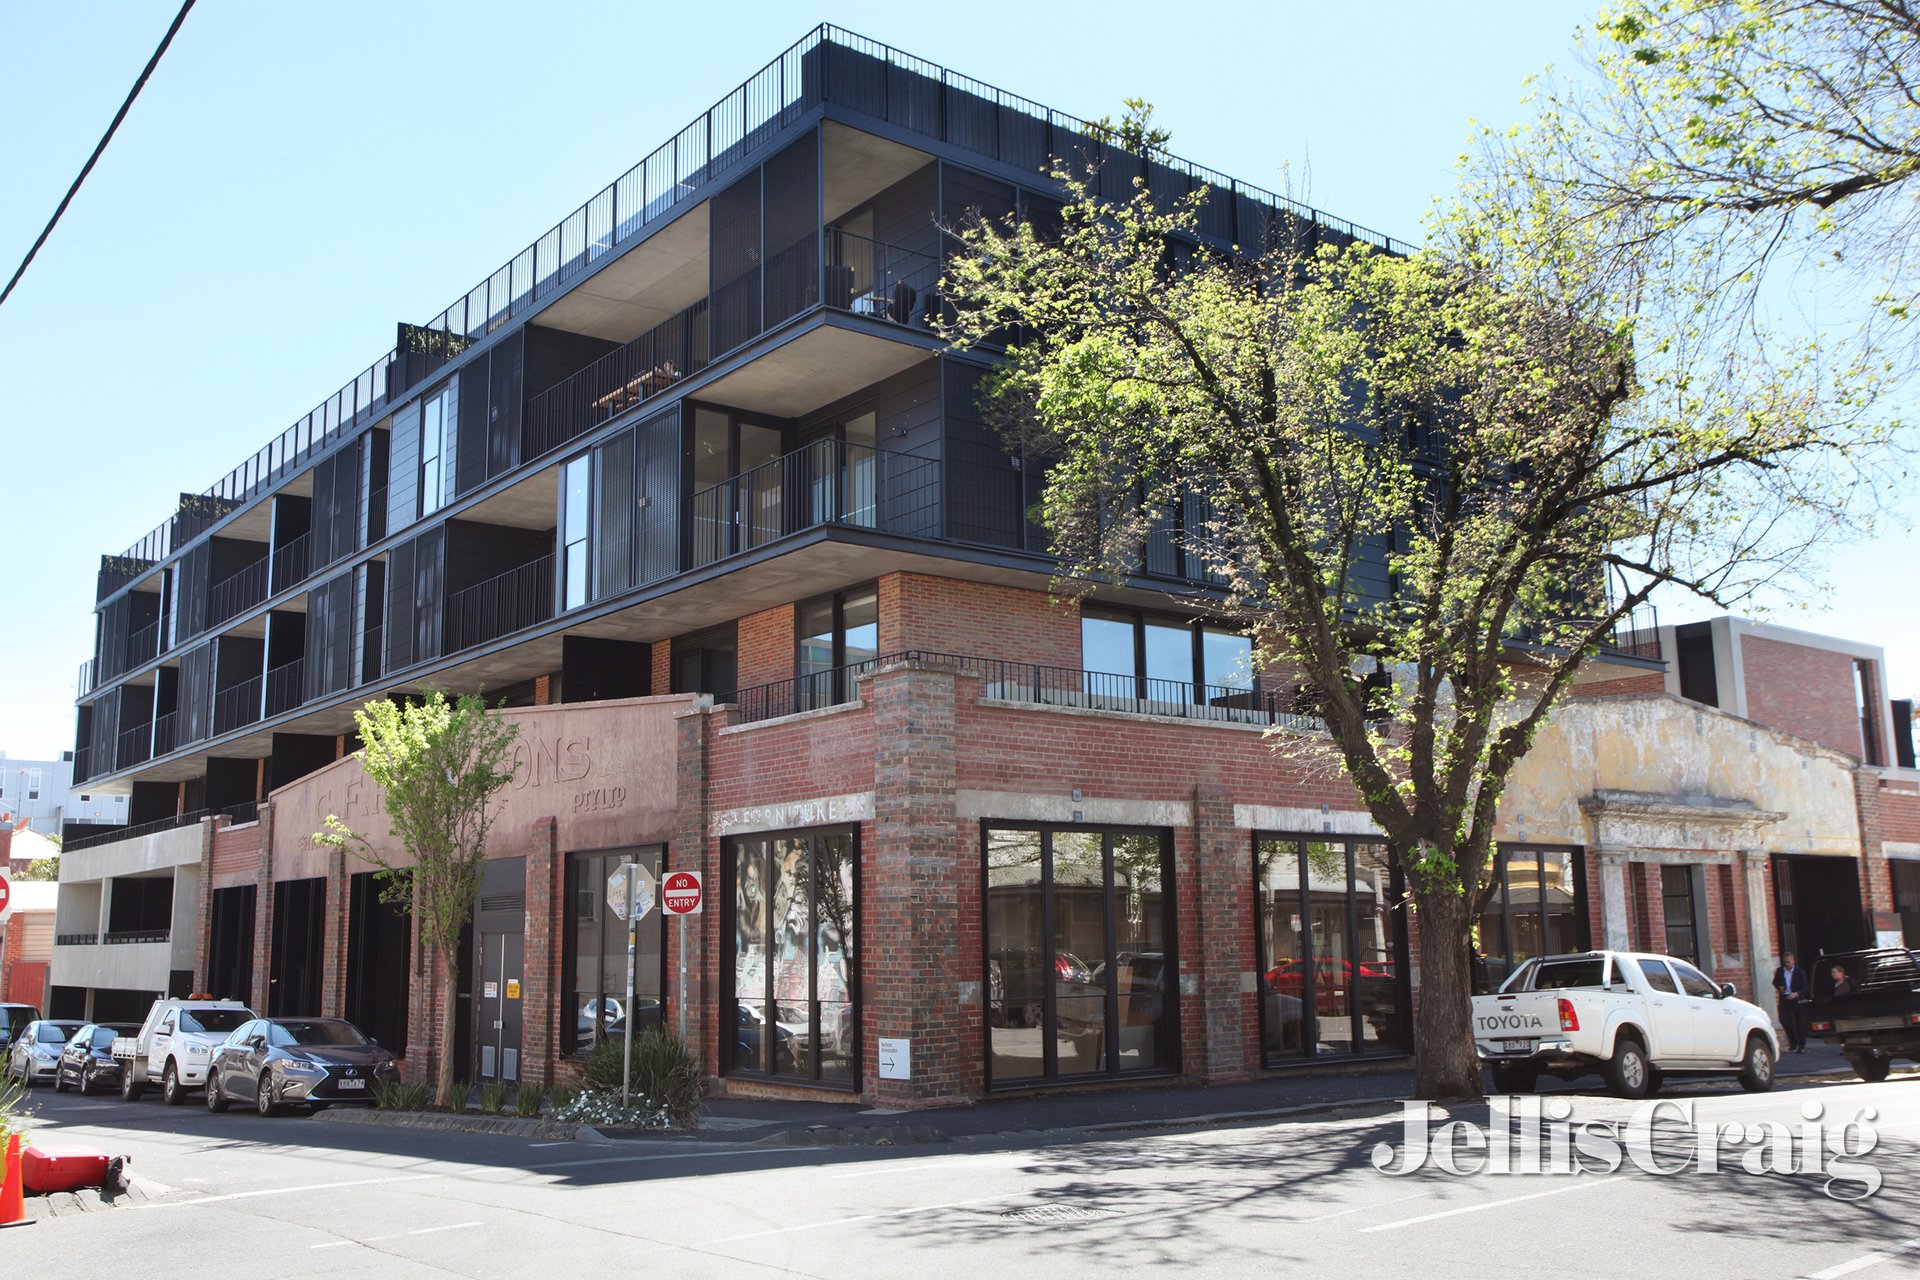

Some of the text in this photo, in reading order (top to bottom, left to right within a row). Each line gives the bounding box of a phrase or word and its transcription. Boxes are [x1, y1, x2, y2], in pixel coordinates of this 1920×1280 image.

[676, 879, 688, 888] NO
[668, 898, 696, 908] ENTRY
[1477, 1014, 1543, 1030] TOYOTA
